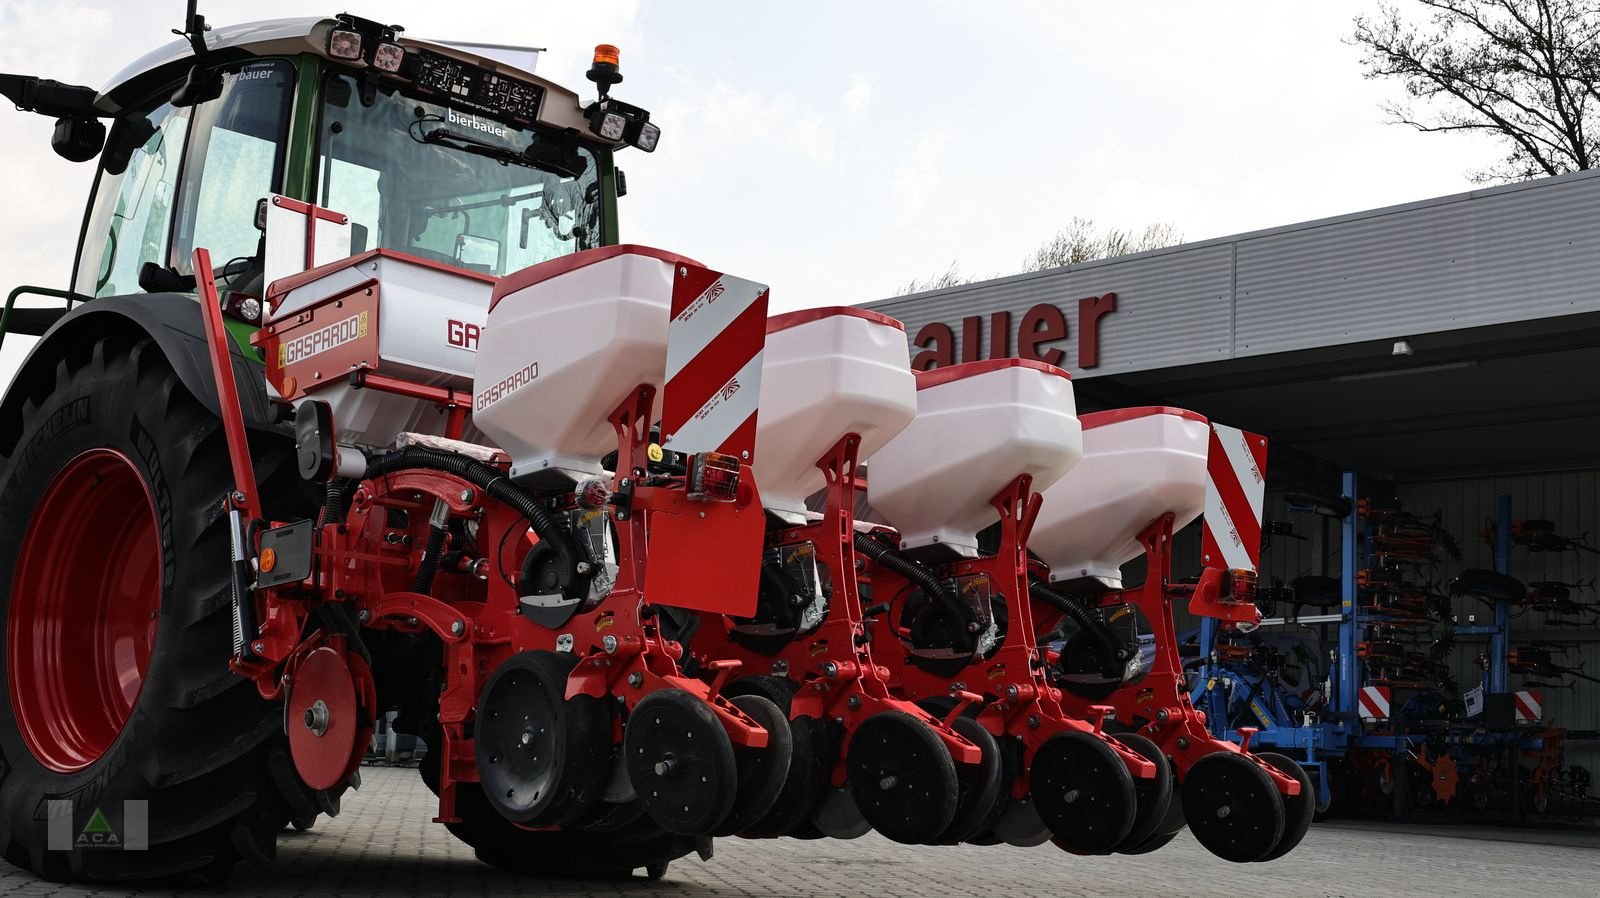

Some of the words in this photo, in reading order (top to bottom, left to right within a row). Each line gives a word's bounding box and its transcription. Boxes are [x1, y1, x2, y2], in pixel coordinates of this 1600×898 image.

[221, 66, 273, 84] erbauer
[448, 107, 507, 138] bierbauer
[287, 317, 358, 363] GASPARDO
[447, 319, 480, 350] GA
[476, 361, 539, 412] GASPARDO
